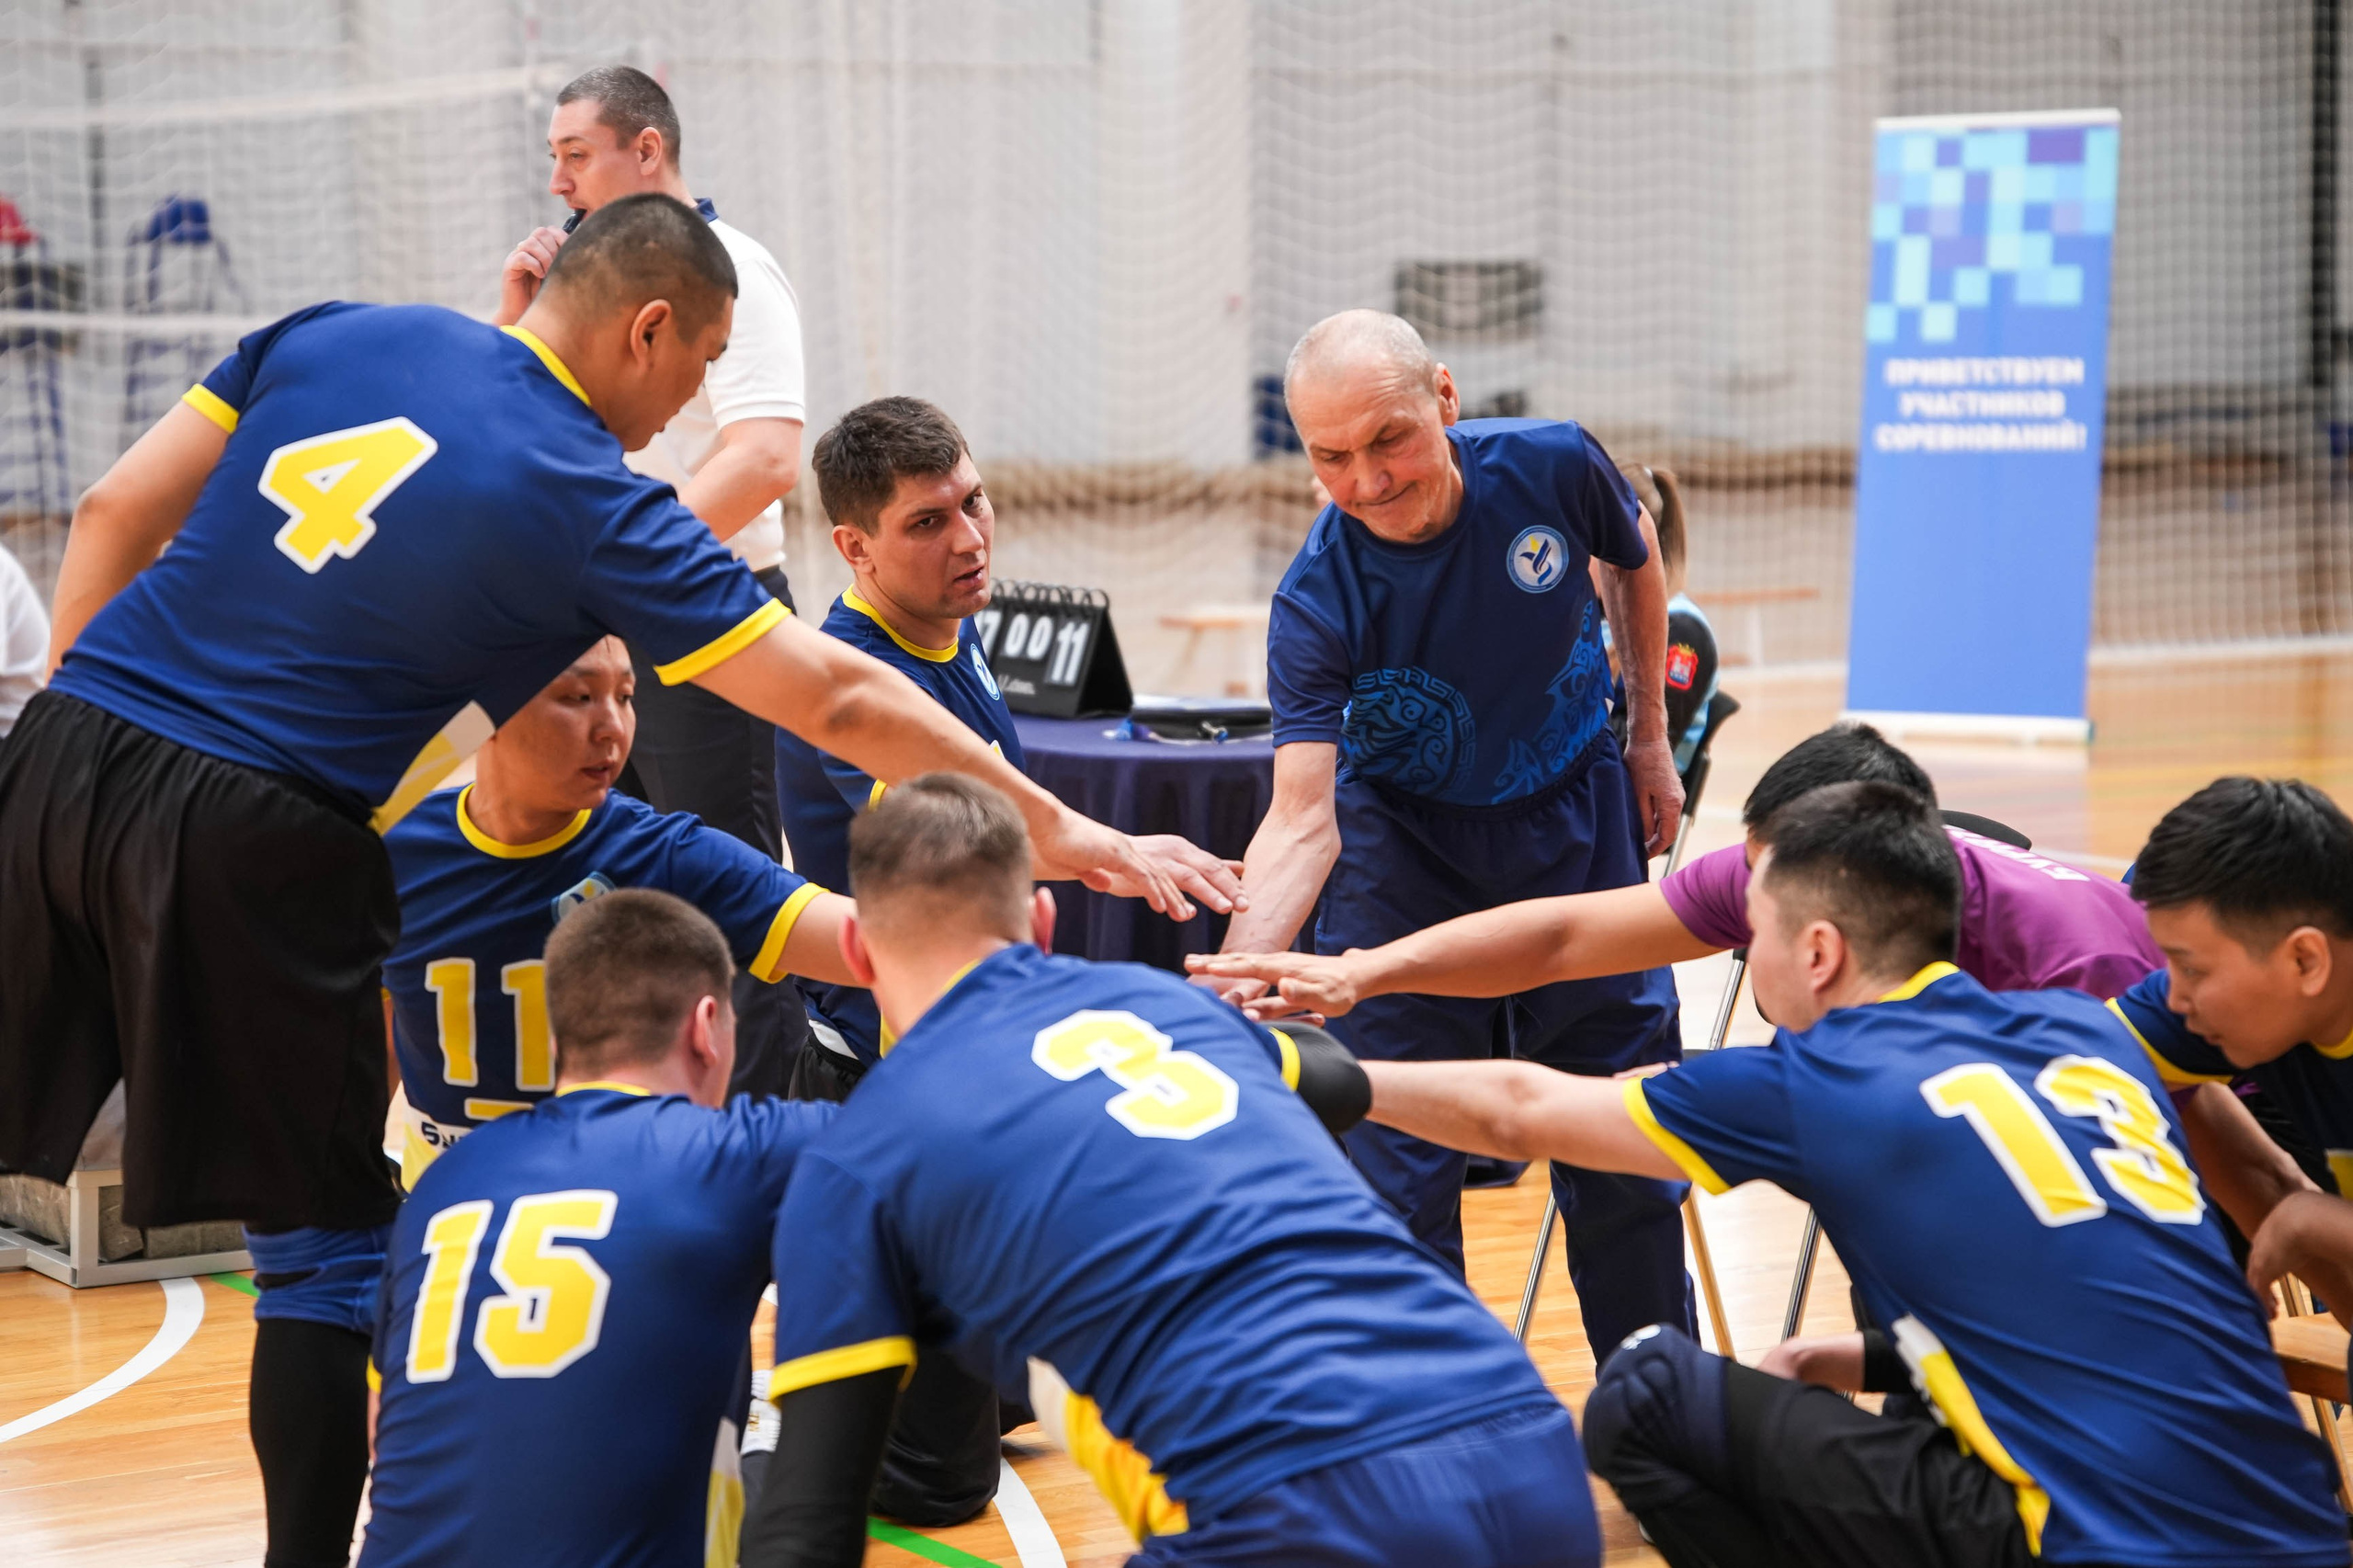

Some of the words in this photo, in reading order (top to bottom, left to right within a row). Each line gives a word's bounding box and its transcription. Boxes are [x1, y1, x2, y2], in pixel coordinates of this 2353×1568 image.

[1875, 419, 2087, 451] СОРЕВНОВАНИЙ!
[1885, 358, 2085, 385] ПРИВЕТСТВУЕМ
[1900, 392, 2066, 418] УЧАСТНИКОВ
[257, 415, 438, 574] 4
[1051, 621, 1090, 686] 11
[425, 957, 556, 1091] 11
[1031, 1009, 1239, 1141] 3
[1919, 1054, 2207, 1227] 13
[405, 1188, 619, 1384] 15
